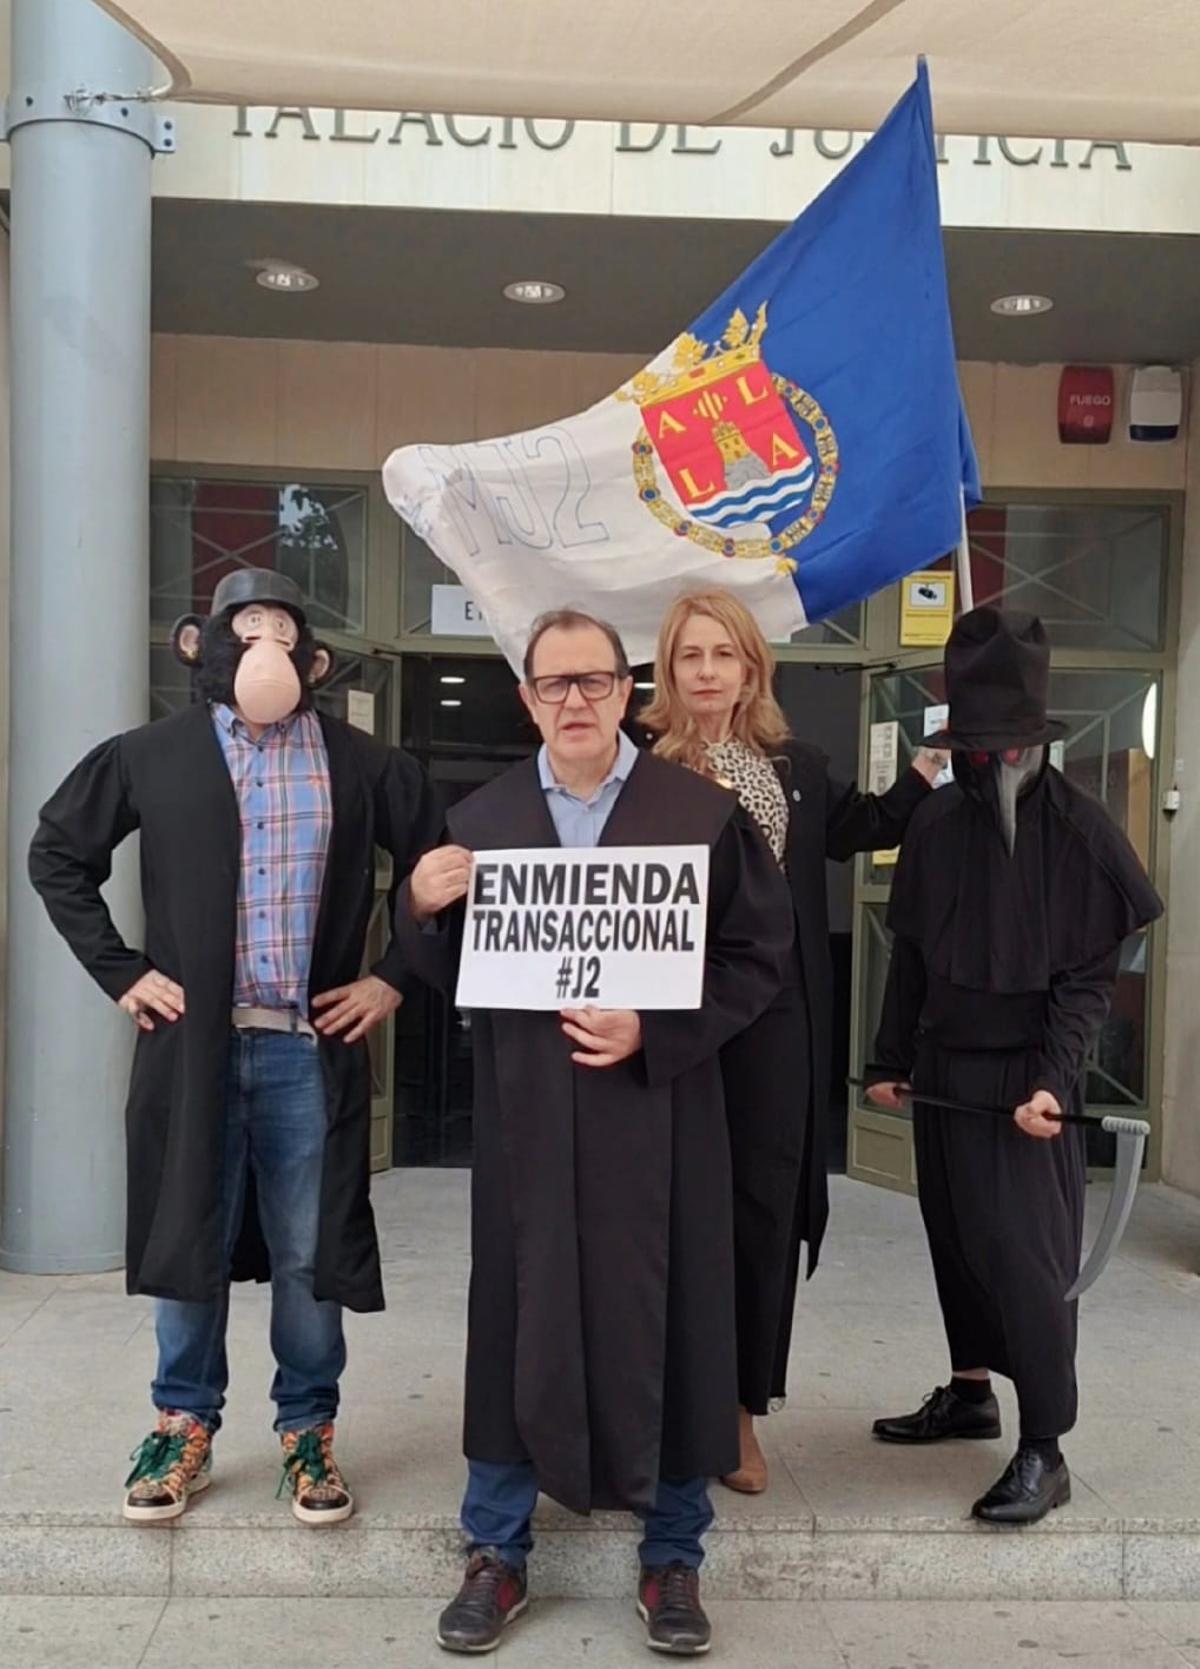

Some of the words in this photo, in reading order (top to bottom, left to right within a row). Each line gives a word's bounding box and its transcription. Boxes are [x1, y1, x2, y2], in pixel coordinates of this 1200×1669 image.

[658, 410, 687, 439] A
[736, 376, 769, 406] L
[1069, 394, 1112, 406] FUEGO
[679, 468, 715, 498] L
[771, 432, 800, 466] A
[473, 862, 700, 905] ENMIENDA
[472, 909, 696, 951] TRANSACCIONAL
[555, 955, 602, 999] #J2
